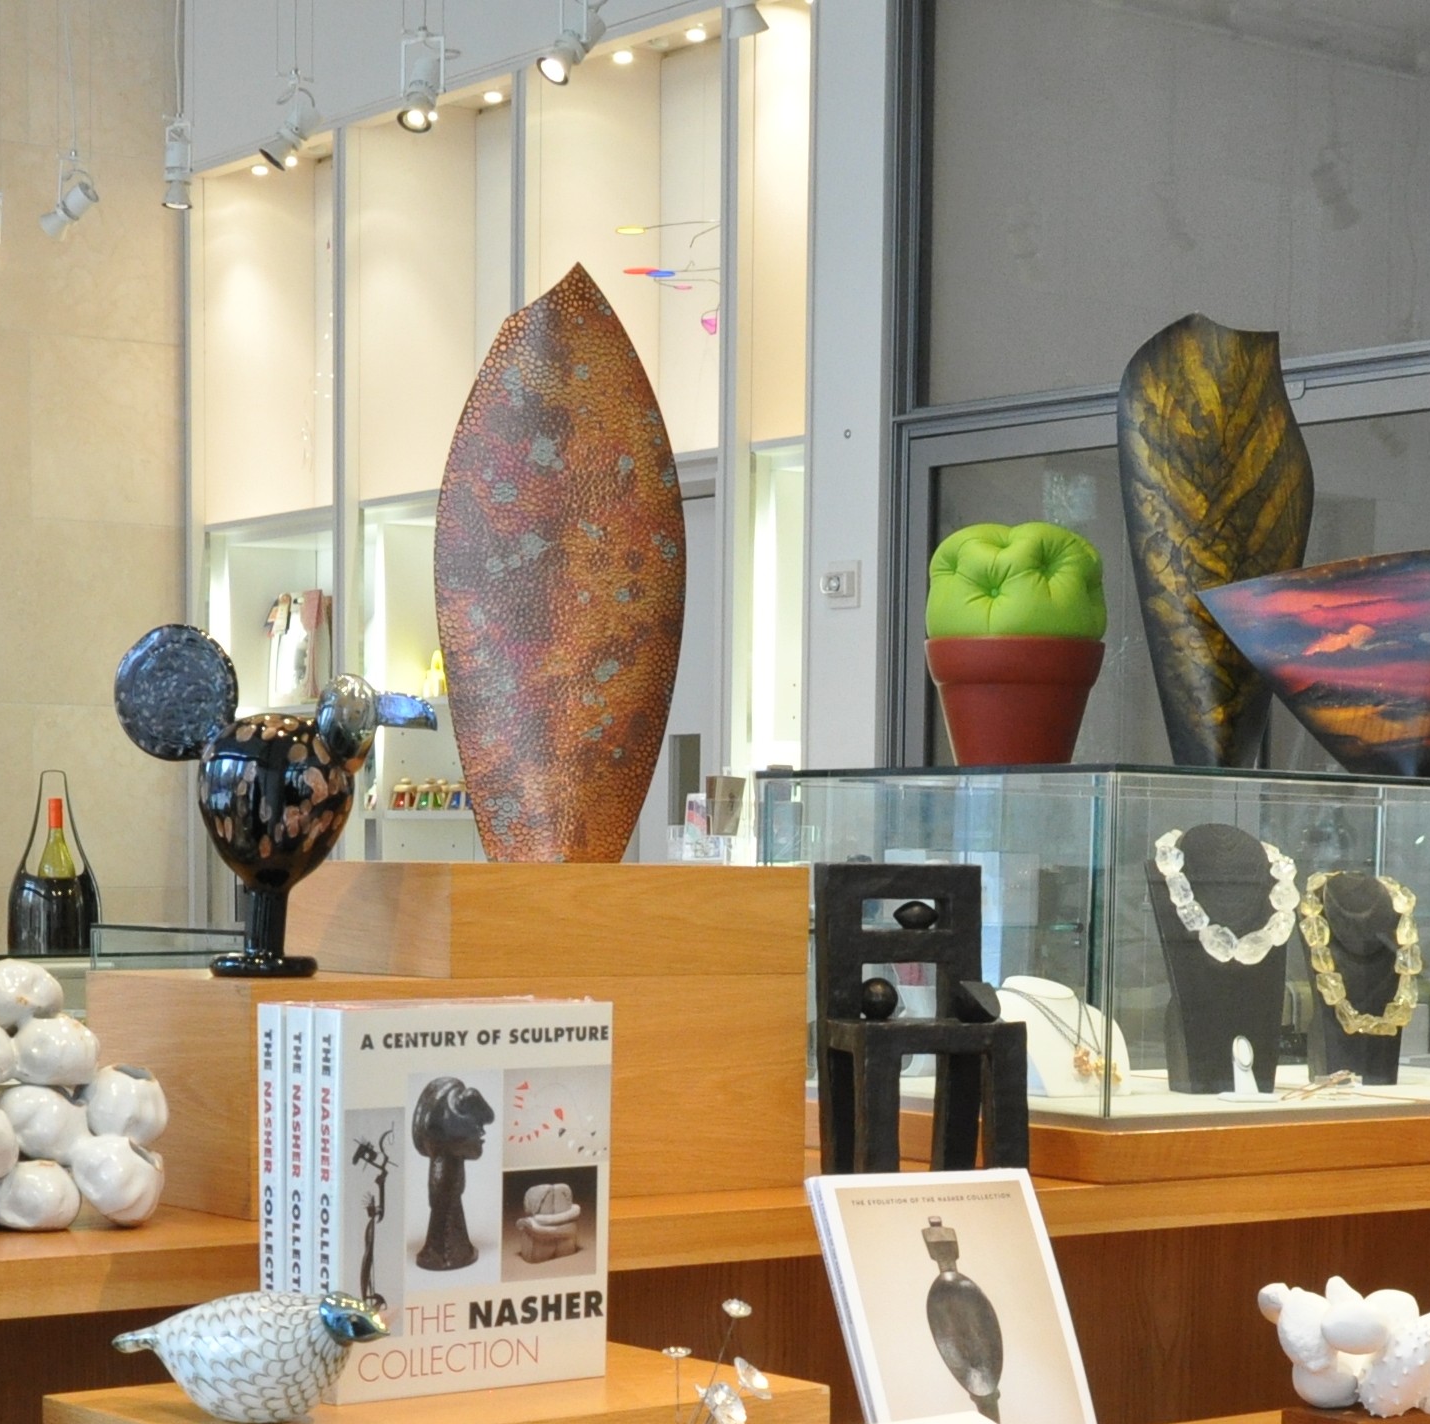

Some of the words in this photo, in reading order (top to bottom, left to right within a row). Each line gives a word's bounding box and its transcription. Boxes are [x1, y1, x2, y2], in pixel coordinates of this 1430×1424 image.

[263, 1029, 273, 1071] THE
[292, 1032, 302, 1074] THE
[322, 1034, 332, 1077] THE
[360, 1034, 375, 1050] A
[382, 1030, 469, 1050] CENTURY
[476, 1029, 502, 1046] OF
[509, 1025, 610, 1045] SCULPTURE
[263, 1081, 273, 1175] NASHER
[292, 1084, 302, 1179] NASHER
[321, 1087, 331, 1183] NASHER
[867, 1198, 908, 1206] EVOLUTION
[937, 1195, 964, 1203] NASHER
[966, 1193, 1011, 1201] COLLECTION
[264, 1185, 274, 1292] COLLECTI
[291, 1189, 302, 1294] COLLECTI
[320, 1194, 330, 1296] COLLECT
[406, 1303, 456, 1336] THE
[468, 1290, 605, 1330] NASHER
[357, 1335, 540, 1383] COLLECTION
